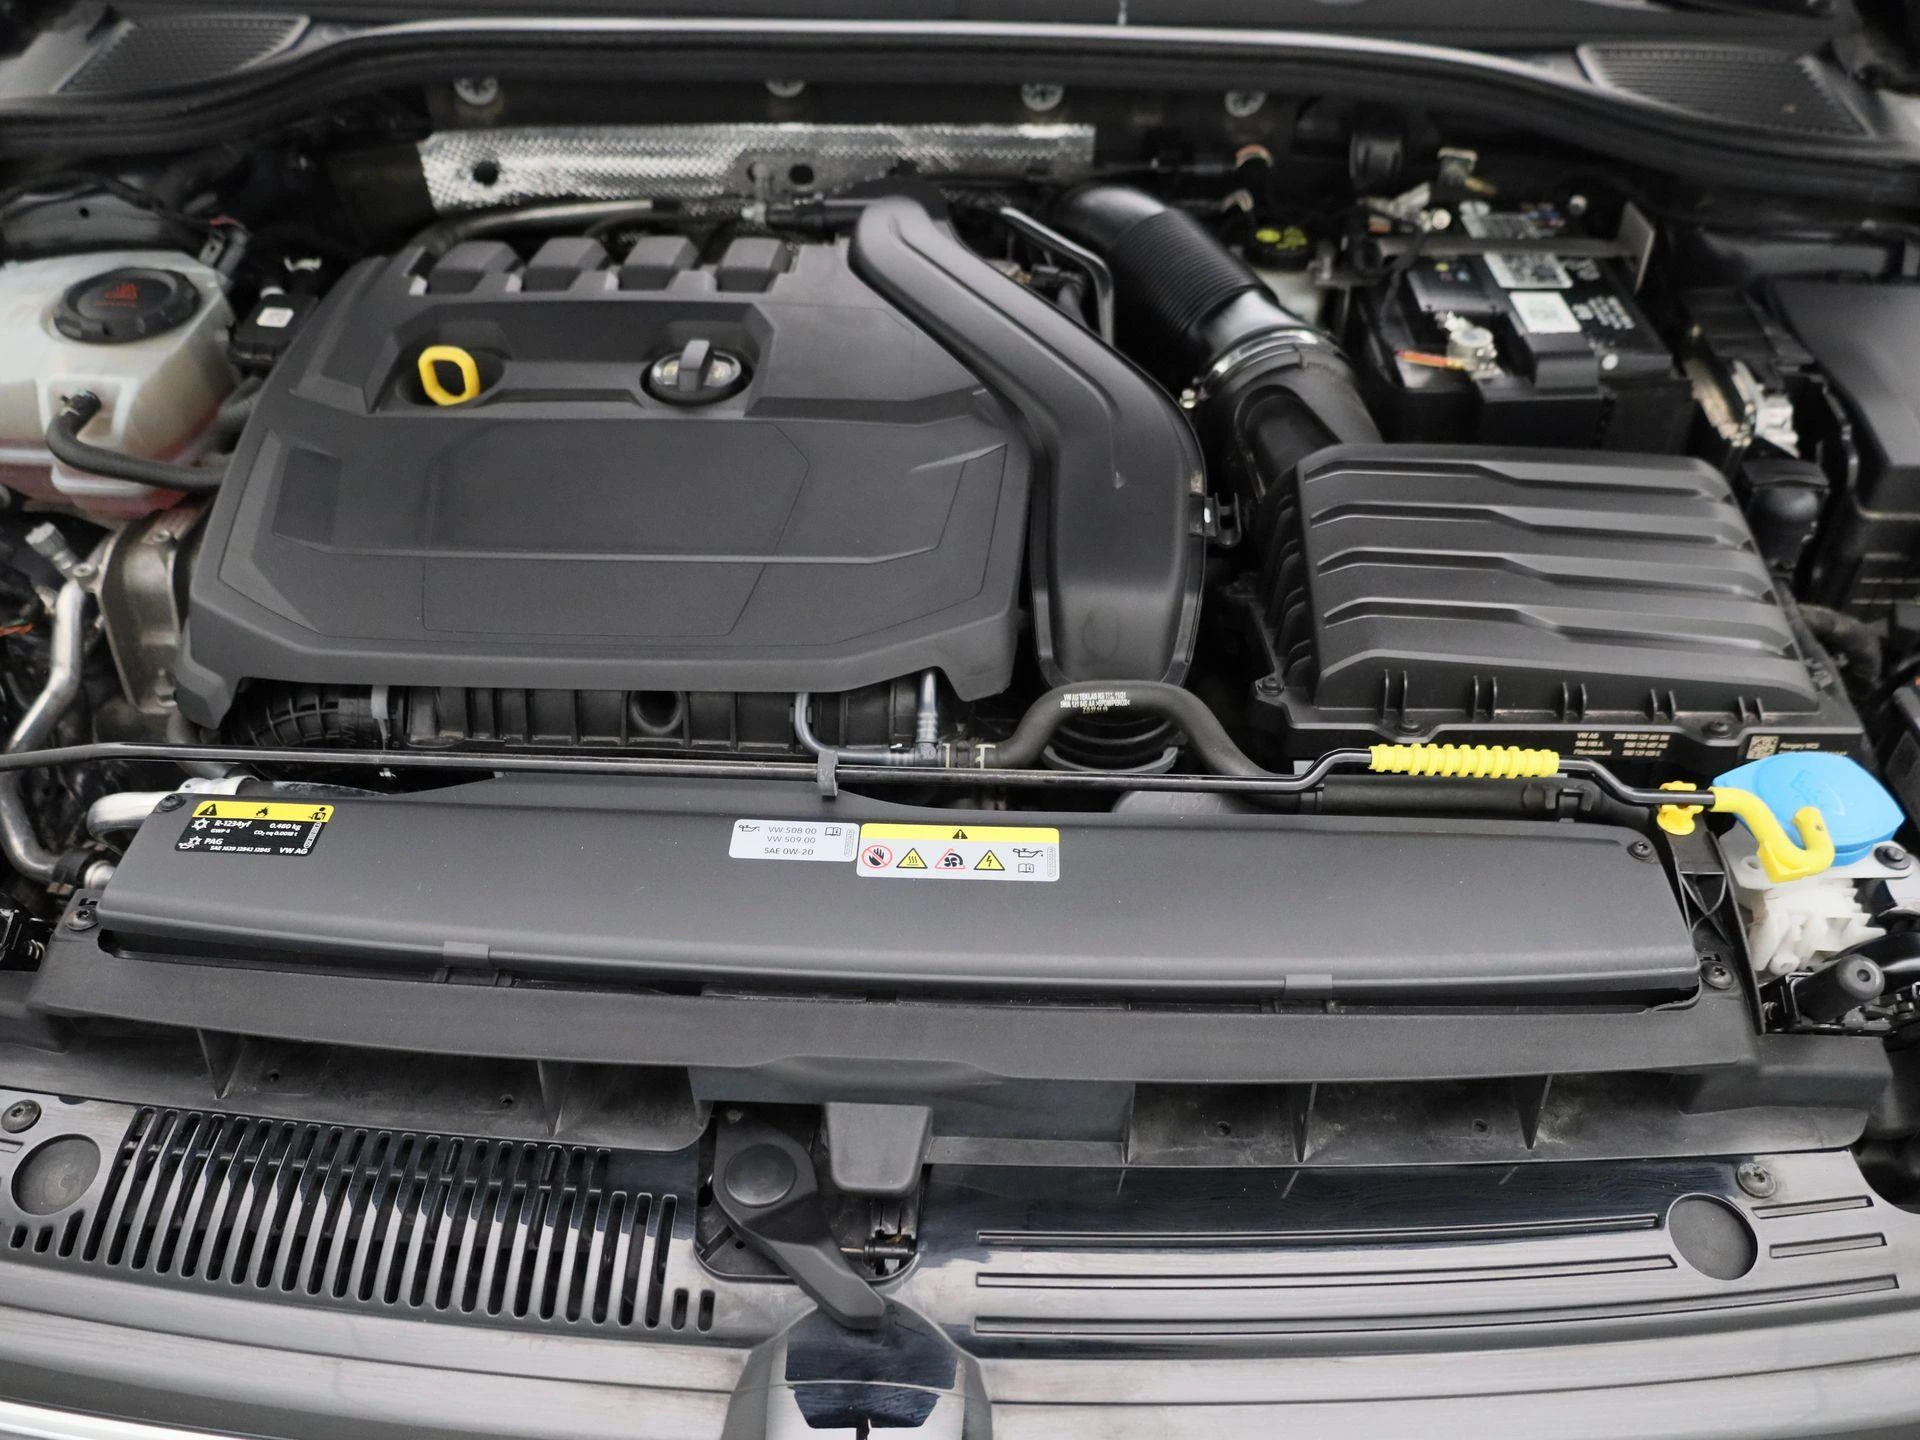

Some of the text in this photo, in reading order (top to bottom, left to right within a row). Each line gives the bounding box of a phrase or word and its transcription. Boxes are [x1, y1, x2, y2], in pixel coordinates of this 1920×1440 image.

[214, 820, 252, 828] R-1234yf
[291, 823, 302, 832] kg
[768, 826, 784, 834] VW
[805, 827, 817, 835] 00
[784, 836, 802, 844] 509
[764, 847, 814, 856] SAE 0W-20
